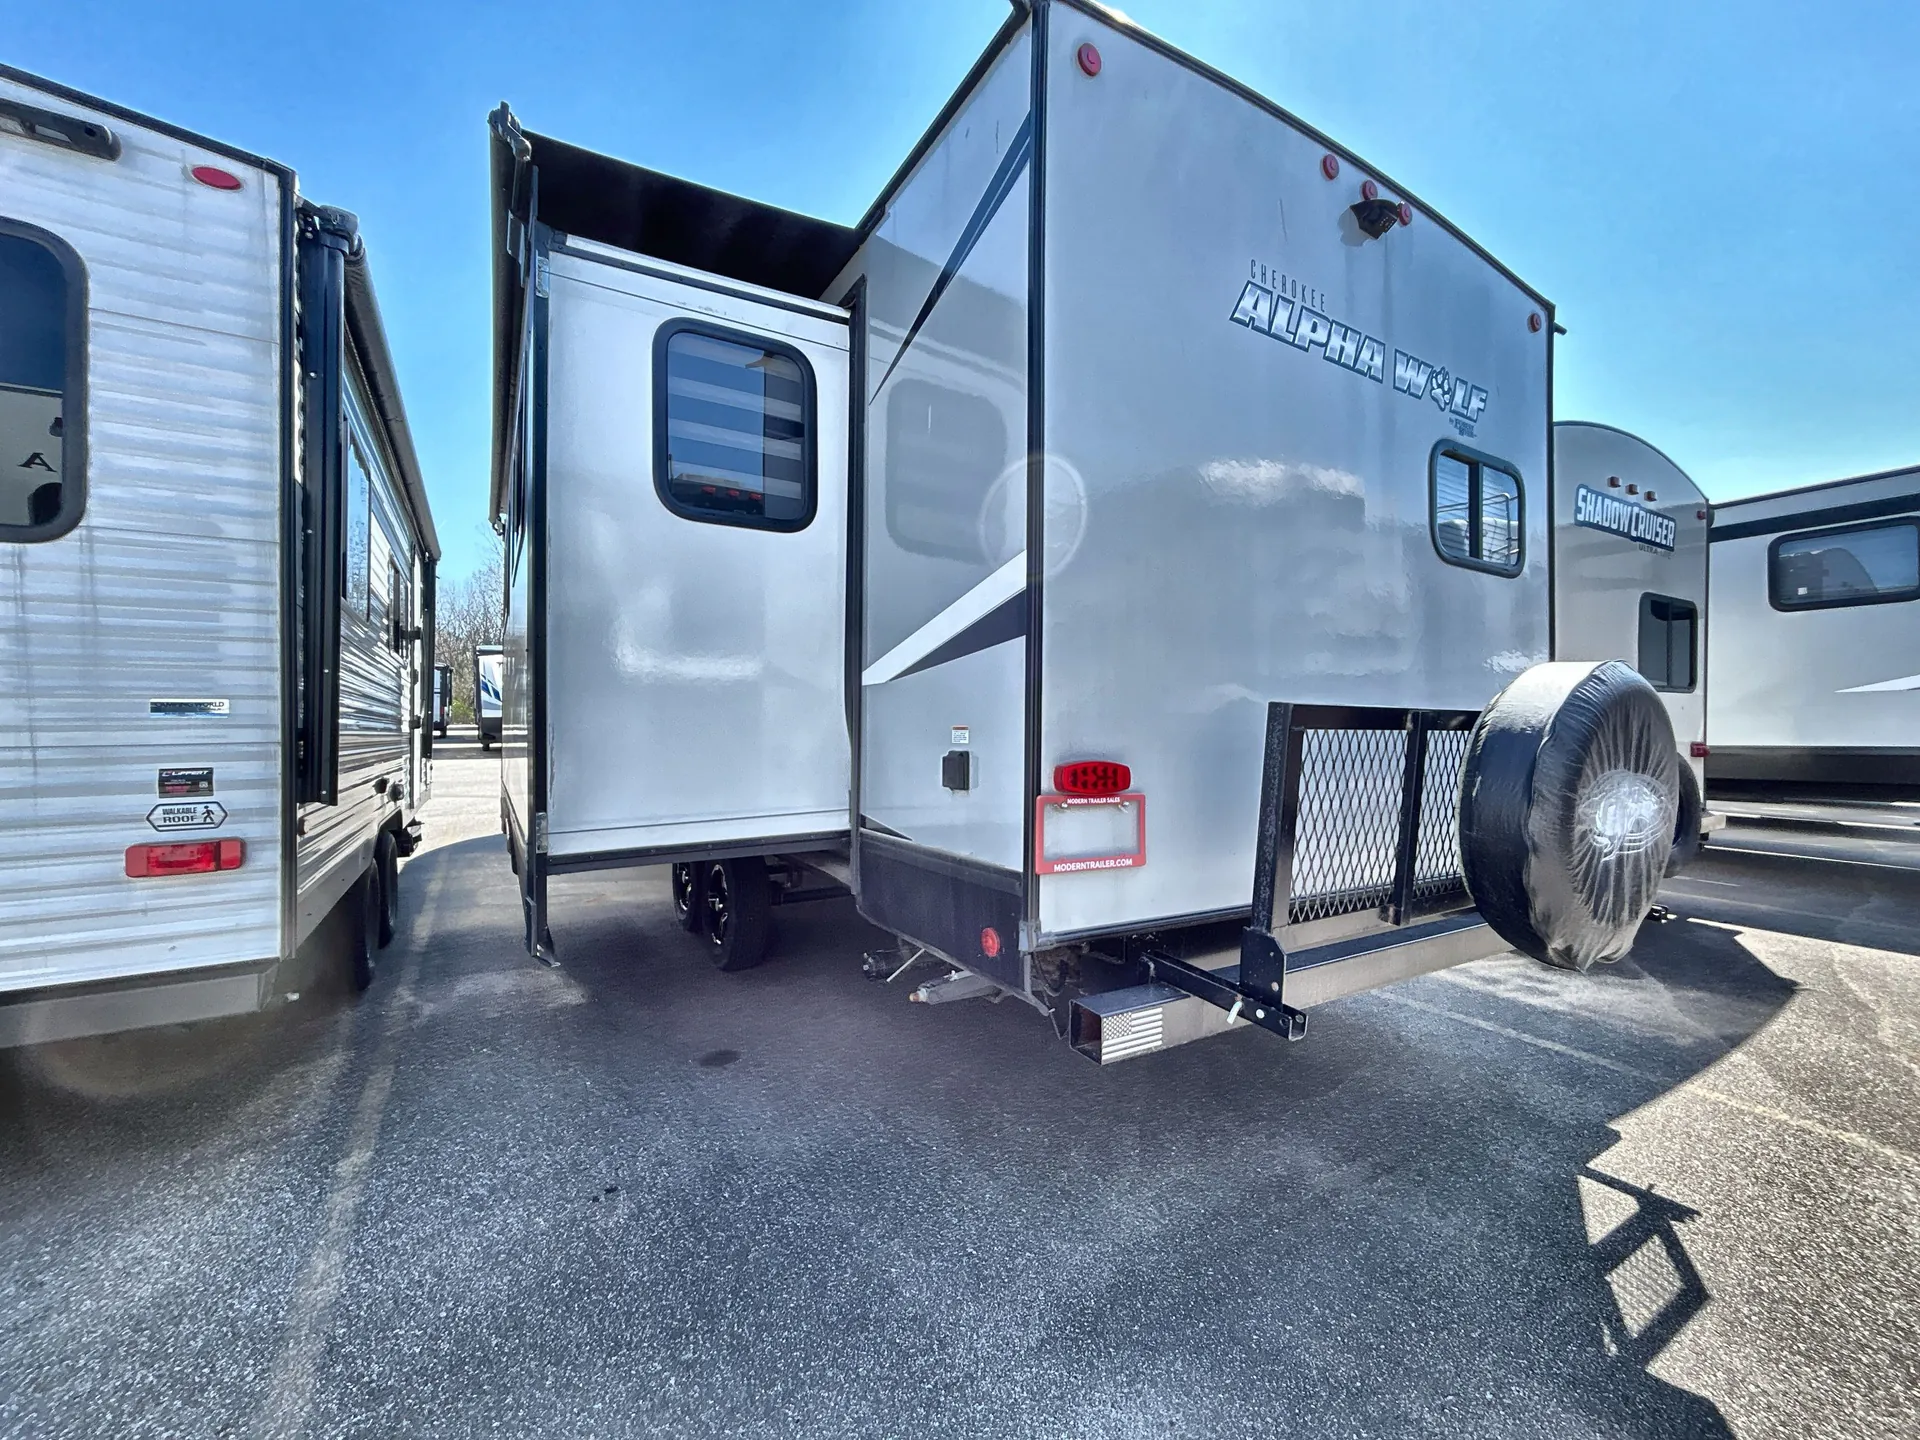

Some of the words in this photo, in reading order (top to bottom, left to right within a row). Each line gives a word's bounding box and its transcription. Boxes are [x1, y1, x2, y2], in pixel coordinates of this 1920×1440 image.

[1250, 259, 1326, 312] CHEROKEE
[1229, 280, 1386, 384] ALPHA
[162, 806, 197, 815] WALKABLE
[163, 815, 197, 823] ROOF
[1053, 858, 1132, 872] MODERNTRAILER.COM
